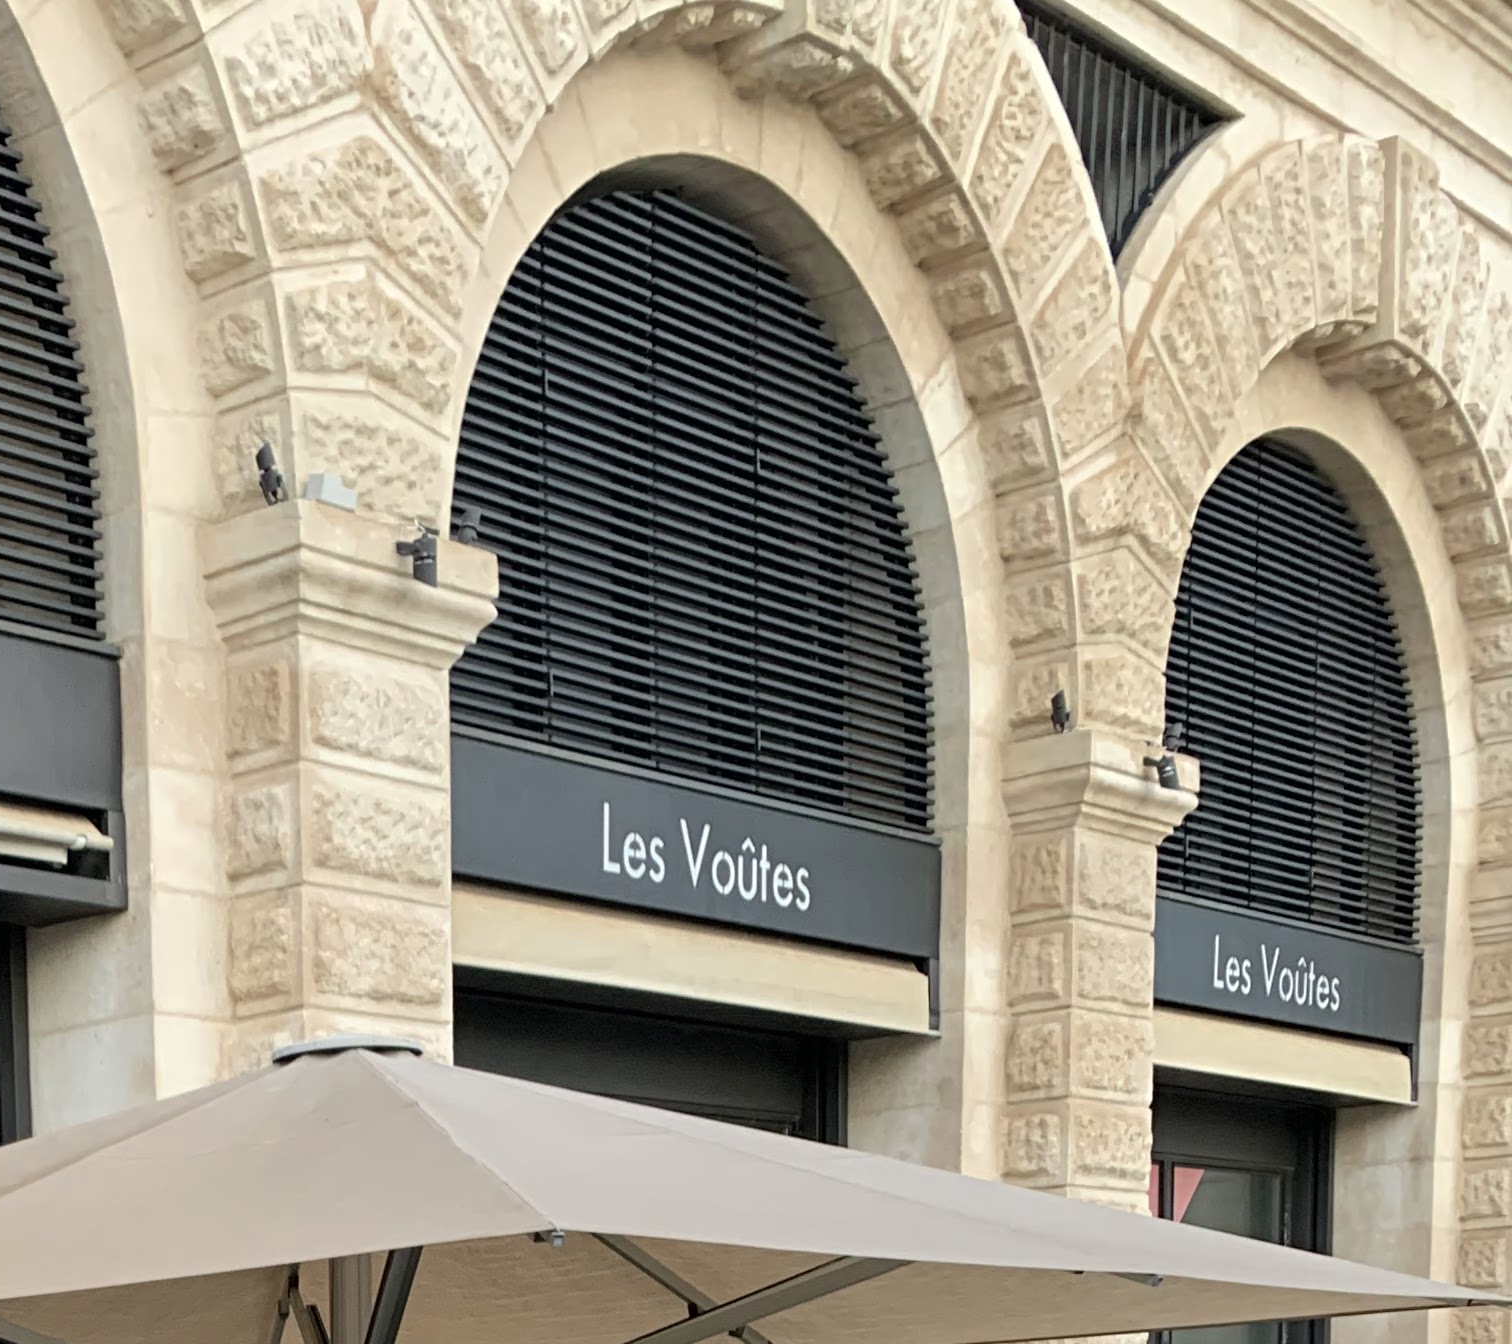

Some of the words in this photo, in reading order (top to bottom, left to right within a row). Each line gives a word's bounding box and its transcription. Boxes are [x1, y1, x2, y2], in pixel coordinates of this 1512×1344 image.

[603, 802, 665, 883] Les
[680, 818, 810, 911] Voûtes
[1213, 934, 1251, 995] Les
[1261, 944, 1340, 1011] Voûtes
